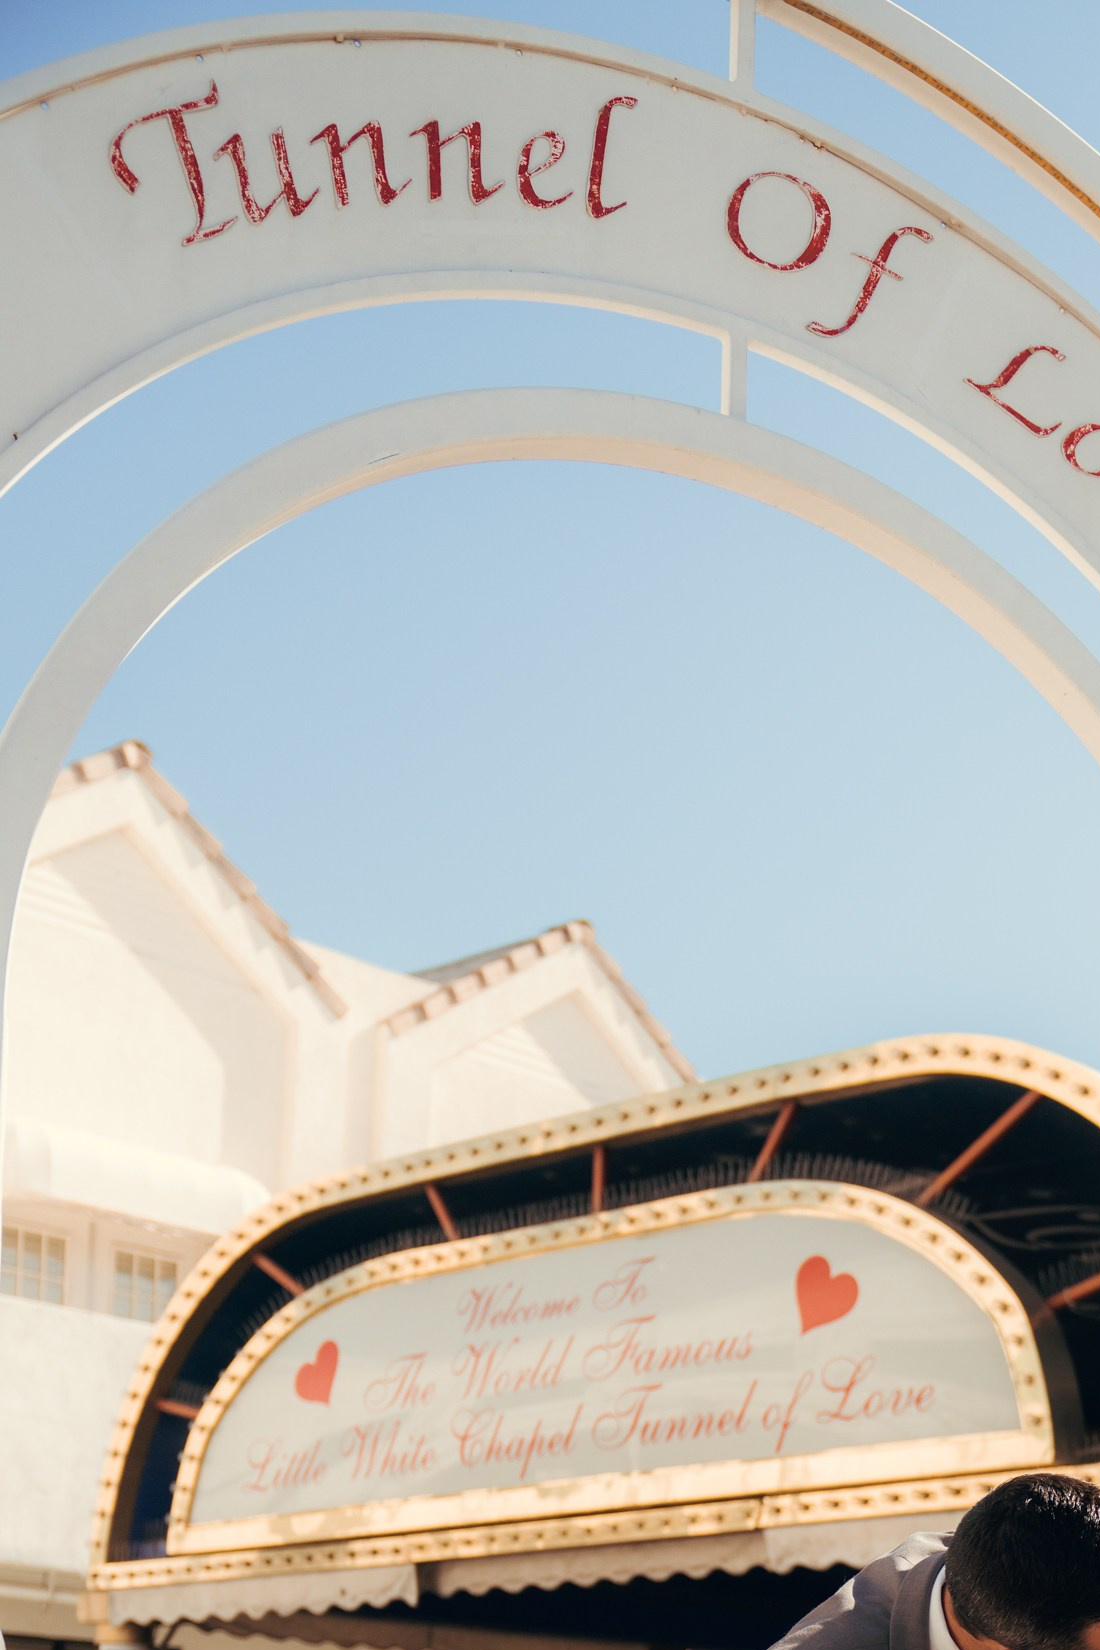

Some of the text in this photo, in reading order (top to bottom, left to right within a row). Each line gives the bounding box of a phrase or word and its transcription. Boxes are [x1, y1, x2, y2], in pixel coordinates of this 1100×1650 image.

[107, 79, 639, 248] Tunnel
[725, 169, 934, 338] Of
[456, 1256, 657, 1334] Welcome To
[242, 1354, 936, 1493] Little White Chapel Tunnel of Love
[364, 1315, 754, 1414] The World Famous
